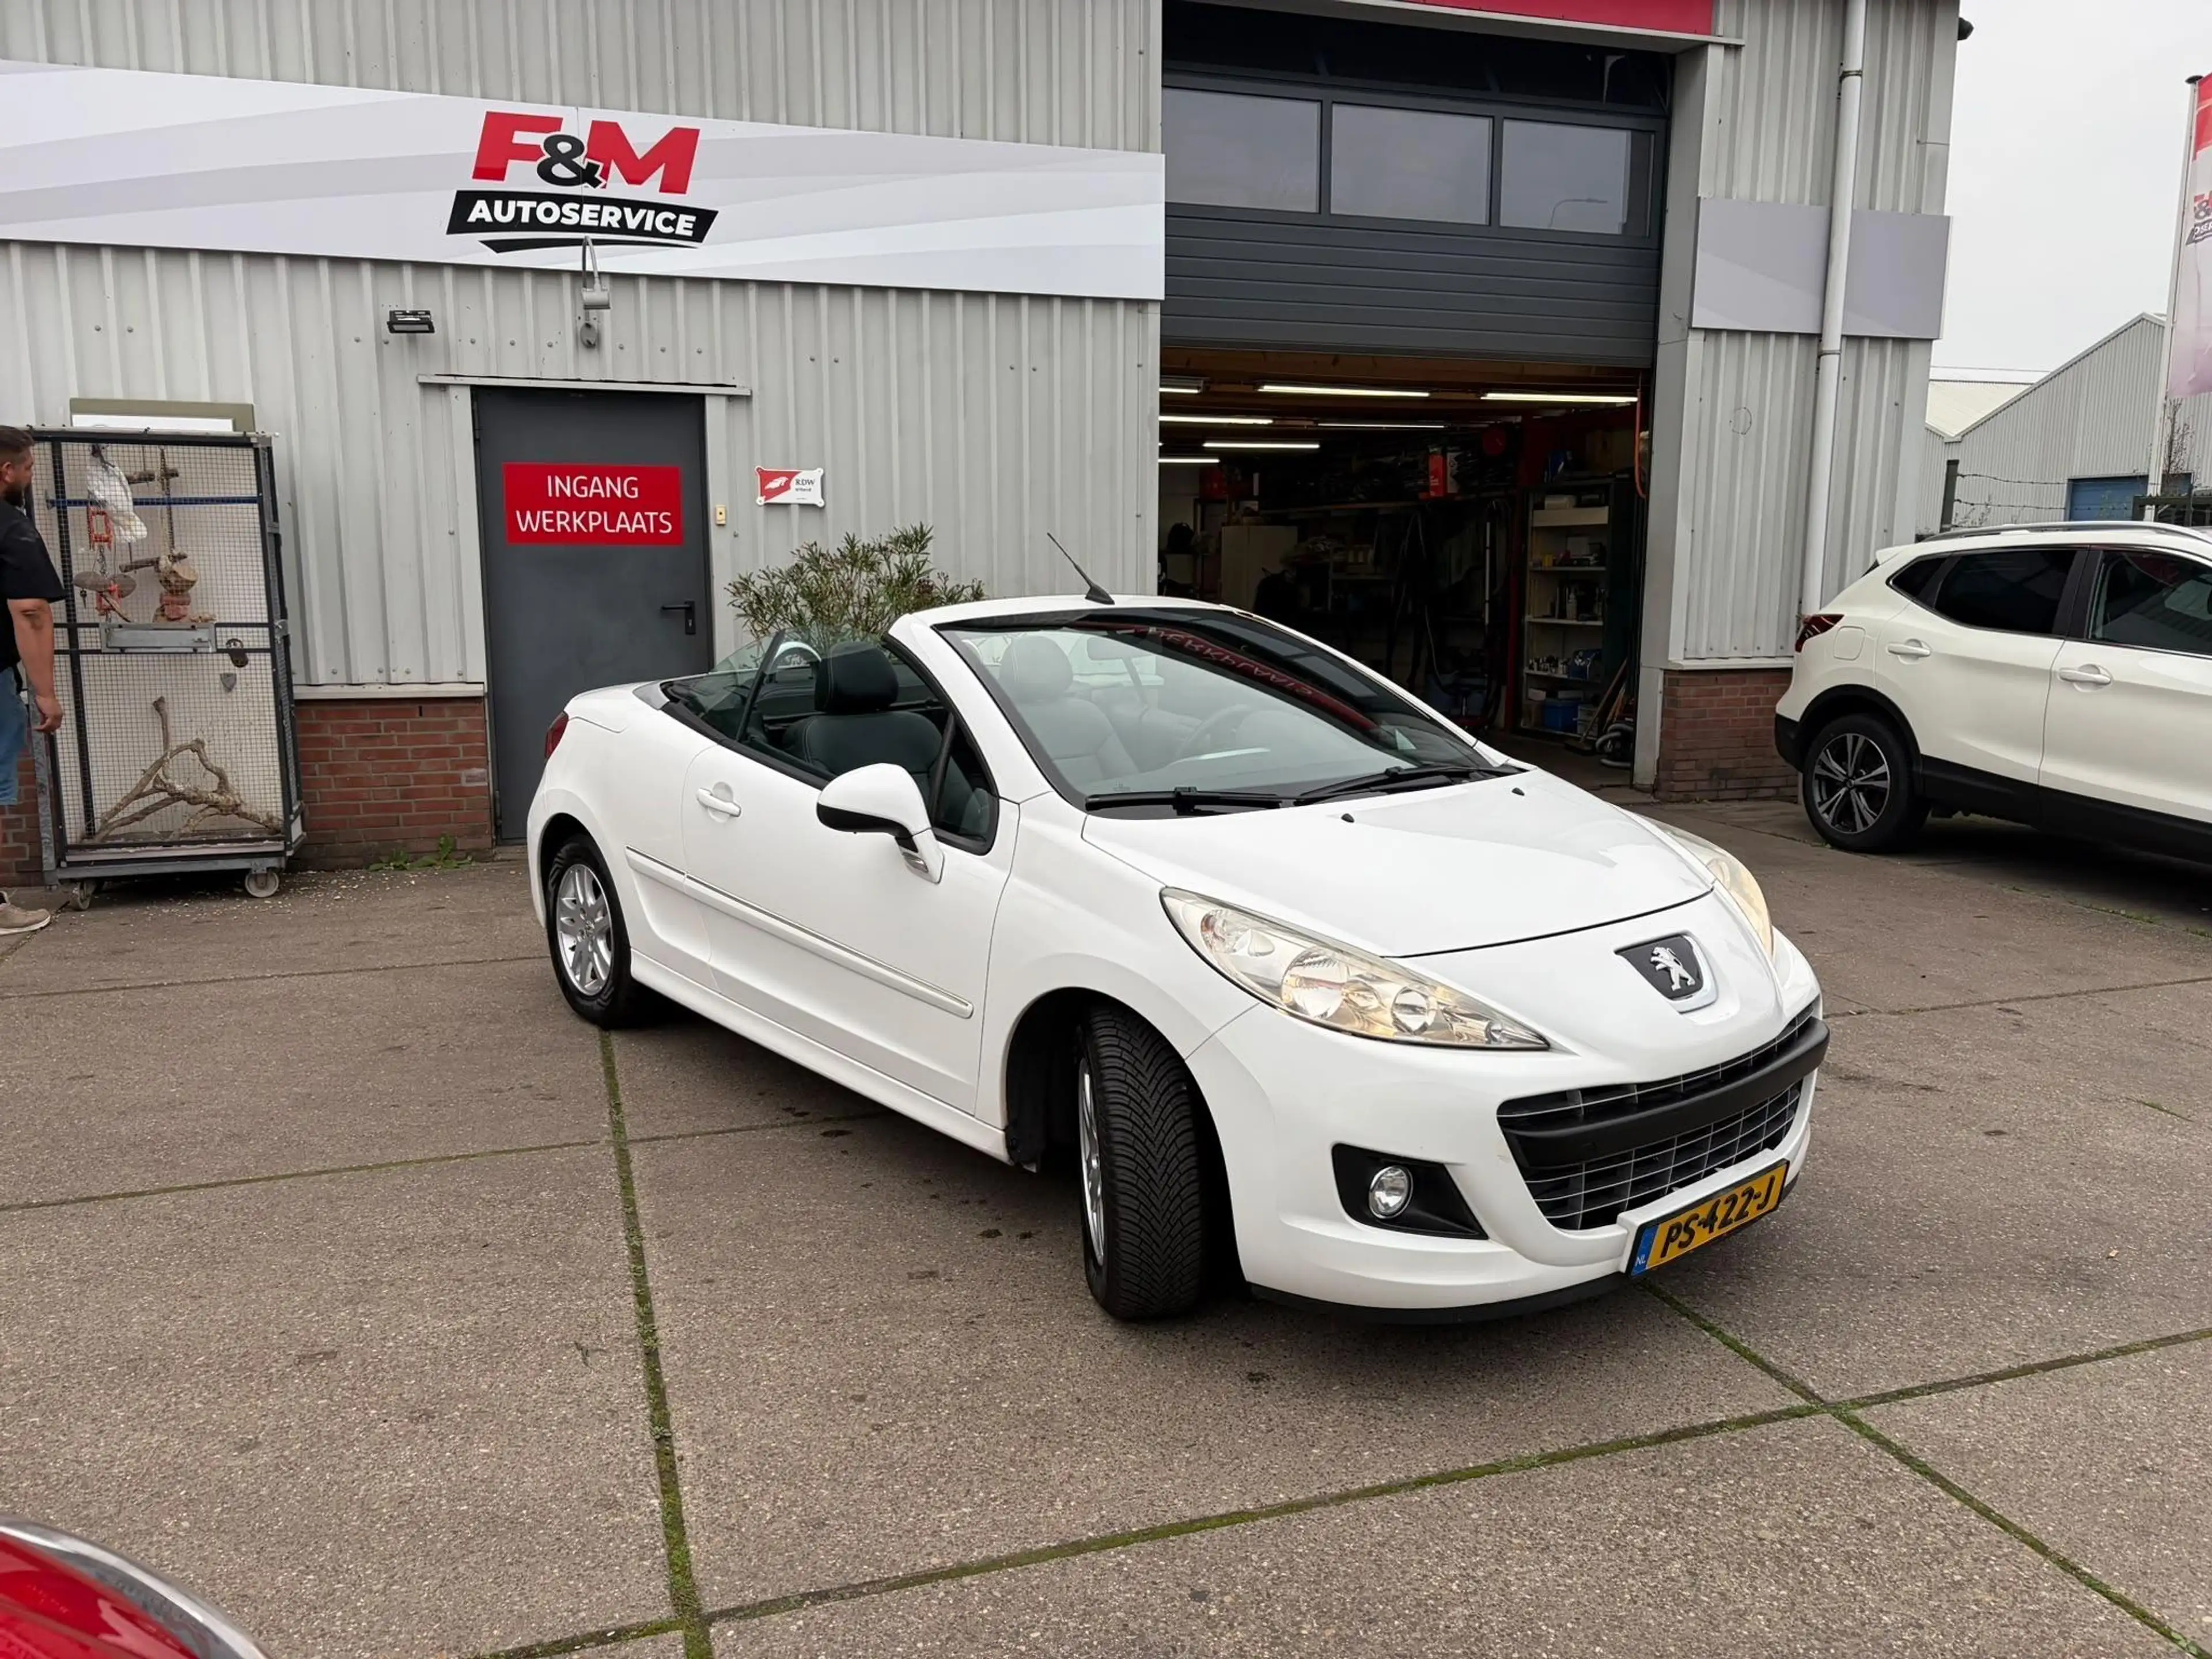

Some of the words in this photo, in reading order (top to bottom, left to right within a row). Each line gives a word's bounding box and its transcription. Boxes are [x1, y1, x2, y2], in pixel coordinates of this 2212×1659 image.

[472, 111, 700, 194] F&M
[467, 200, 696, 236] AUTOSERVICE
[547, 475, 638, 498] INGANG
[516, 510, 672, 533] WERKPLAATS
[1660, 1175, 1775, 1258] PS-422-J
[1635, 1254, 1646, 1267] NL
